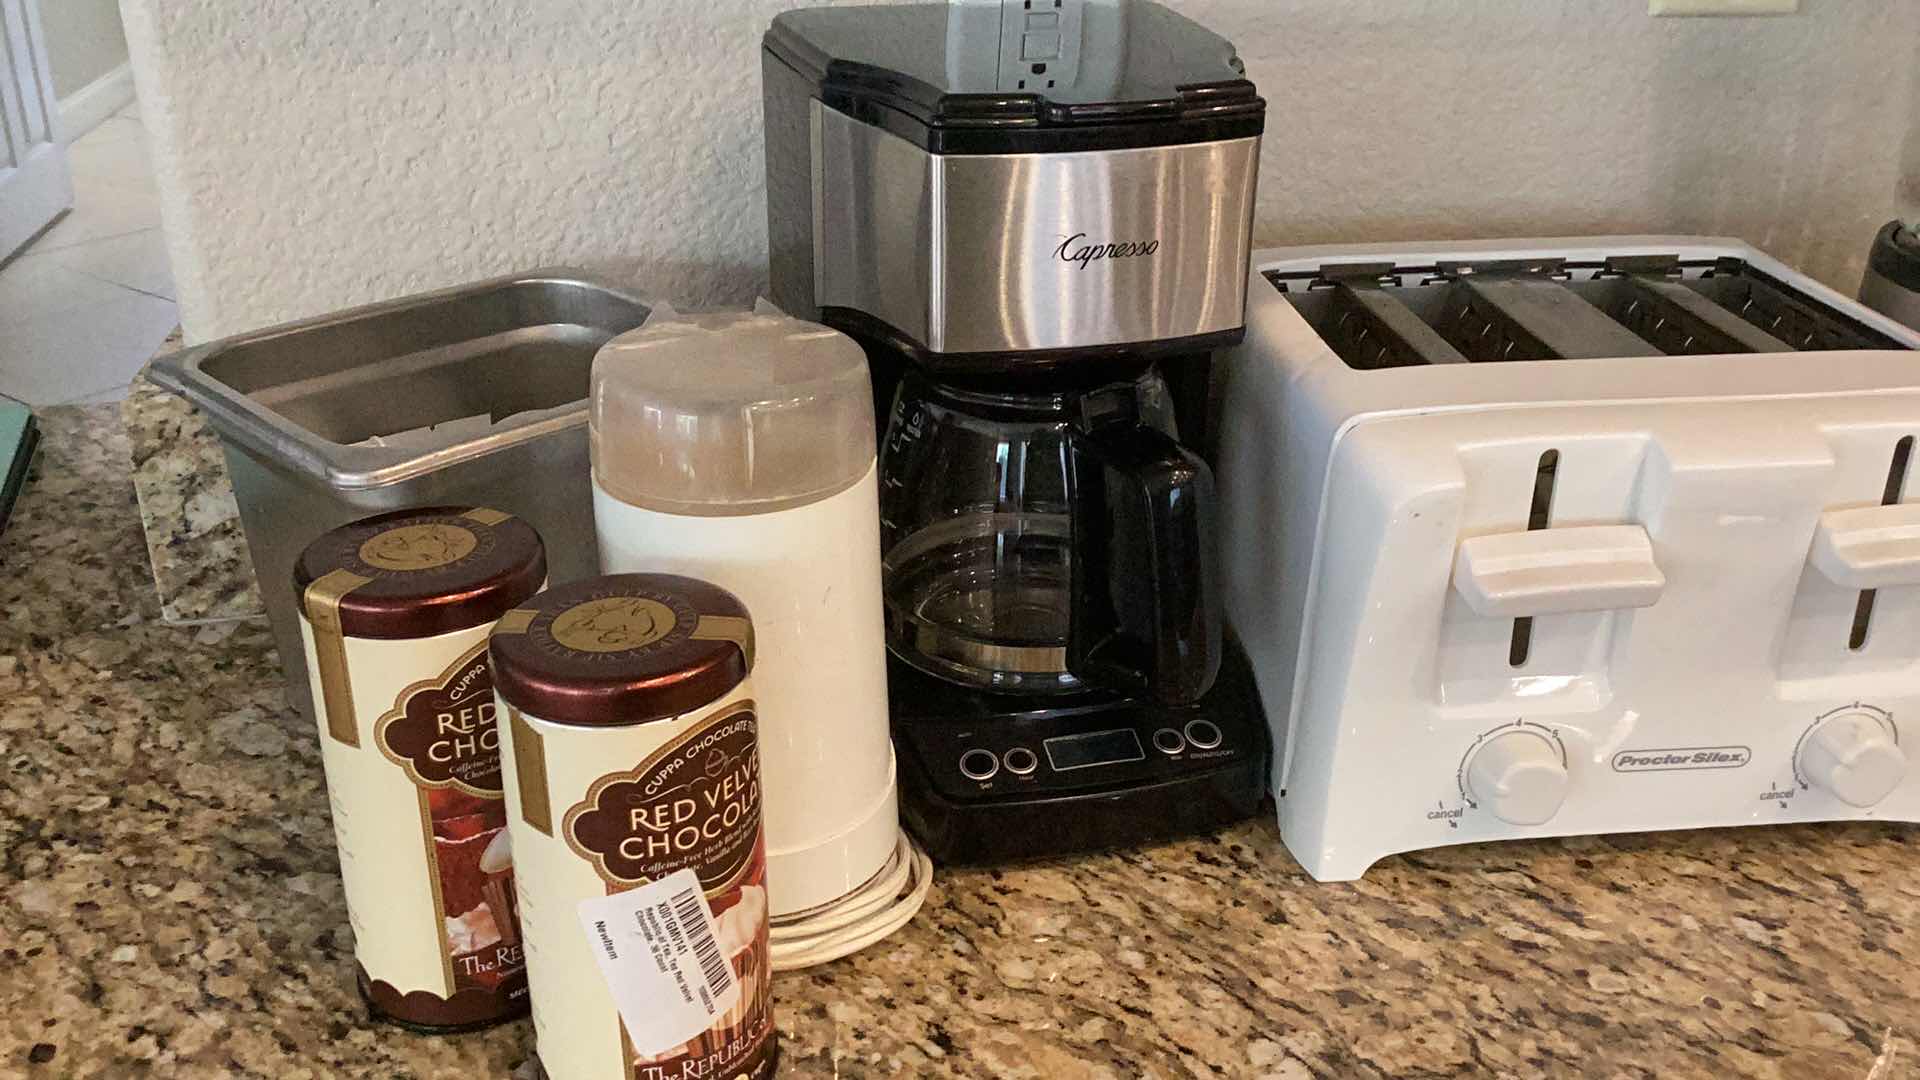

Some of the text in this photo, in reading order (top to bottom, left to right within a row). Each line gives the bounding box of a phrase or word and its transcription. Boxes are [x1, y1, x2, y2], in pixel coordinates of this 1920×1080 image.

[1051, 232, 1159, 270] Capresso
[450, 663, 486, 700] CUPPA
[437, 702, 498, 735] RED
[1515, 717, 1522, 726] 4
[1552, 729, 1559, 738] 5
[428, 727, 500, 763] CHO
[645, 719, 748, 795] CUPPA CHOCOLATE
[1618, 754, 1690, 766] Proctor
[630, 799, 697, 831] RED
[704, 748, 759, 808] VELVE
[1759, 788, 1795, 801] cancel
[619, 781, 759, 861] CHOCOLA
[1427, 807, 1464, 820] cancel
[594, 920, 619, 961] NewItem
[657, 902, 689, 956] X001GMV141
[458, 955, 495, 976] The
[646, 907, 662, 936] Republic
[680, 983, 694, 1003] Velvet
[655, 953, 669, 973] Count
